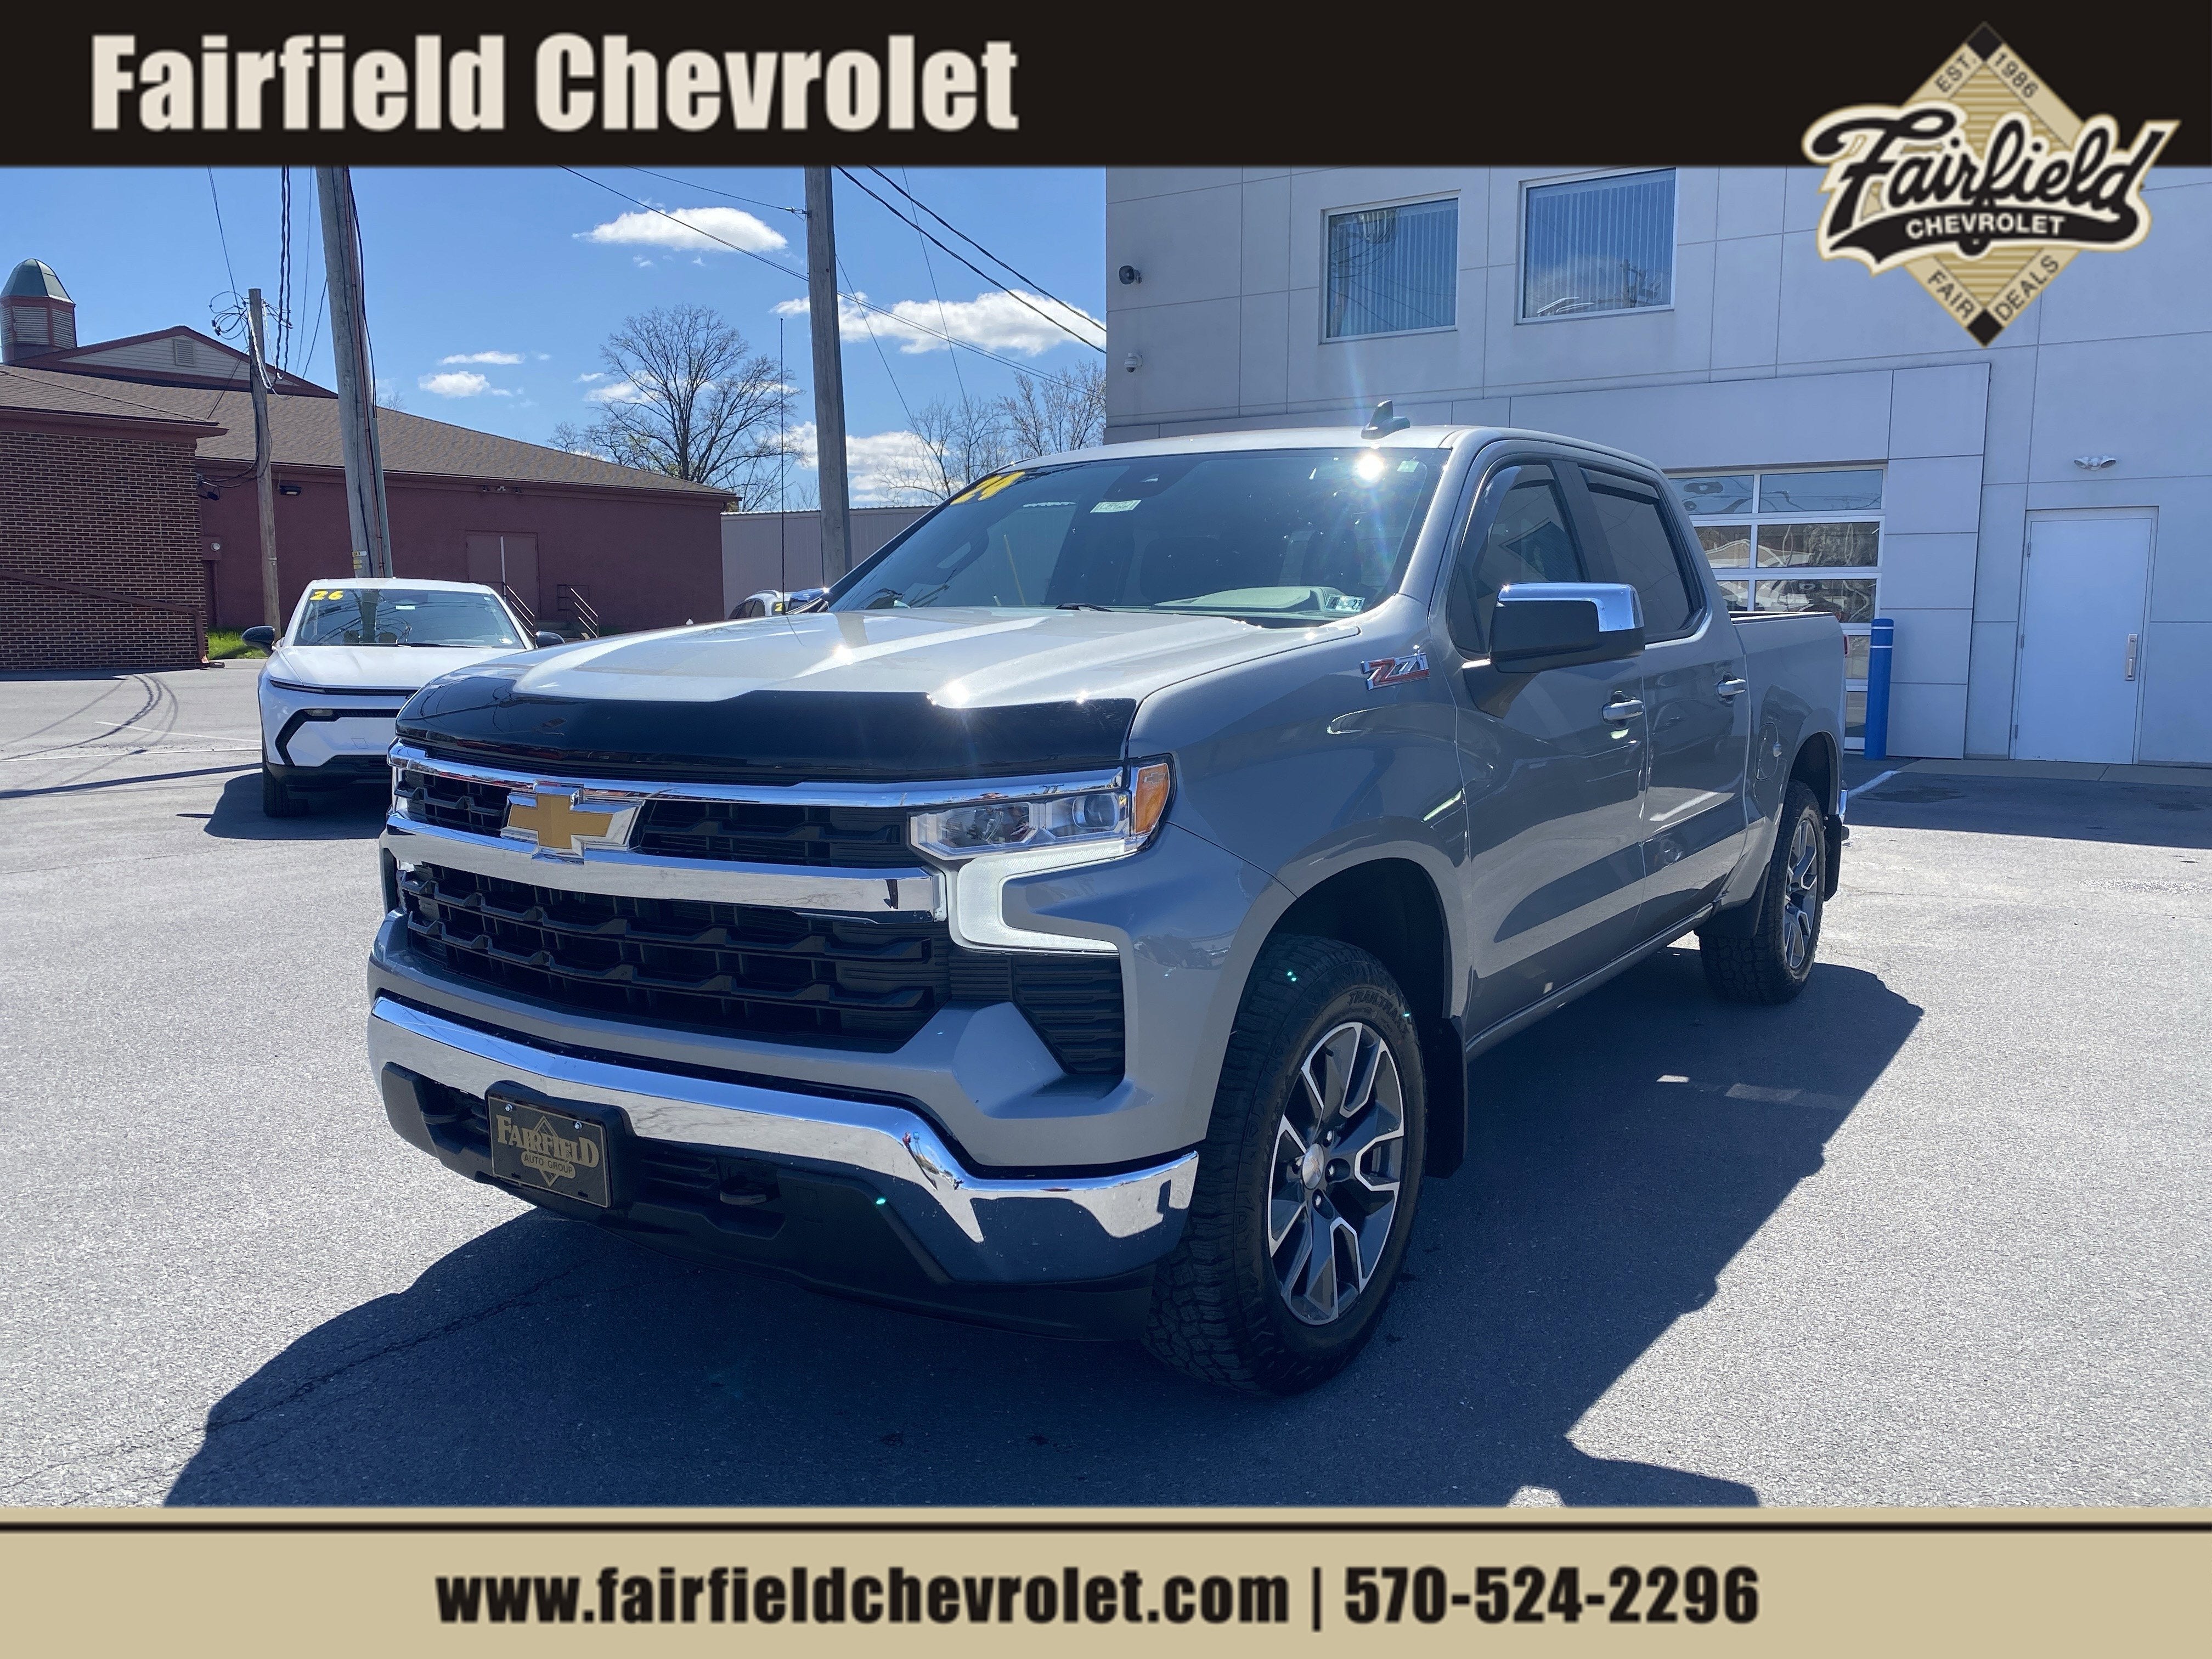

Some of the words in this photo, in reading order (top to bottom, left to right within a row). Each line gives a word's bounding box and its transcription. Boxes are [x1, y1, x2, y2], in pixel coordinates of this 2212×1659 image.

[950, 470, 1026, 506] 24
[309, 590, 344, 601] 26
[1361, 652, 1430, 691] Z71
[495, 1114, 599, 1169] FAIRFIELD
[523, 1153, 544, 1166] AUTO
[547, 1160, 573, 1173] GROUP
